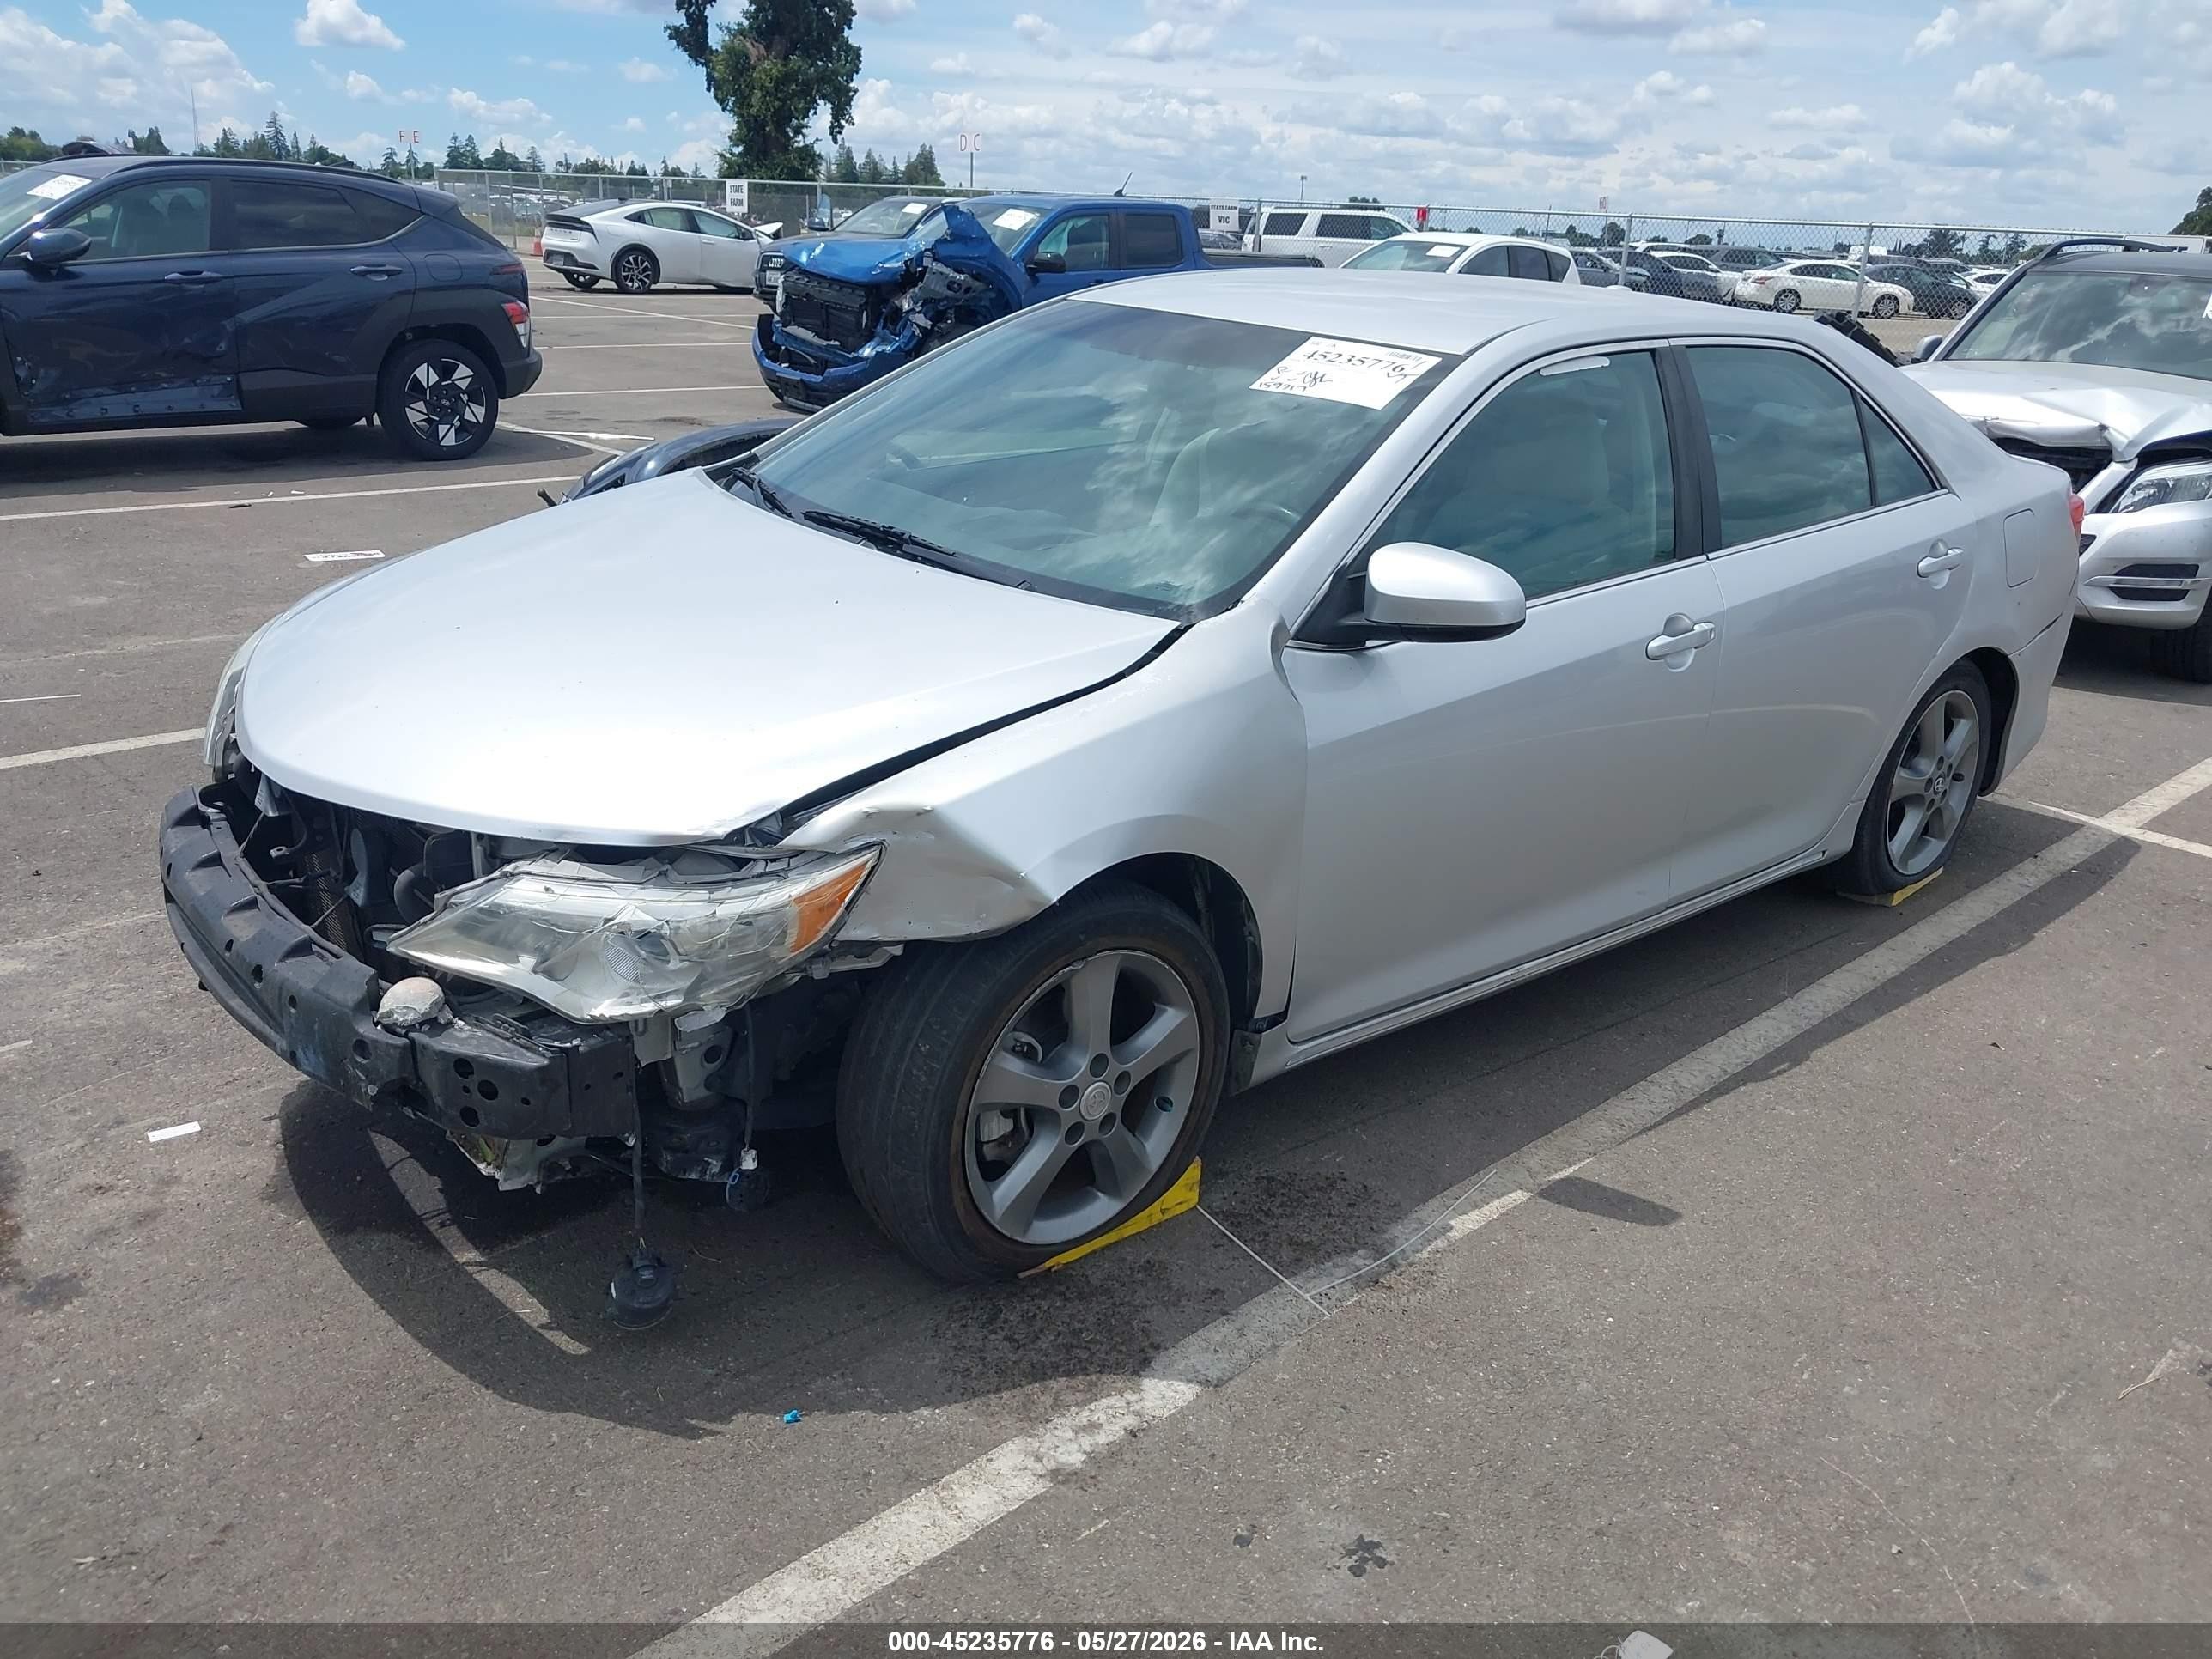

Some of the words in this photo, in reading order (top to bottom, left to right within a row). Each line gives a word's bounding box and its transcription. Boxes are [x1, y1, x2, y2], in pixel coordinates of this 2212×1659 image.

[399, 131, 405, 143] F
[413, 131, 419, 143] E
[961, 134, 967, 152] D
[974, 133, 981, 151] C
[730, 185, 744, 194] STATE
[731, 198, 744, 207] FARM
[1218, 216, 1231, 224] VIC
[1303, 350, 1406, 372] 45235776
